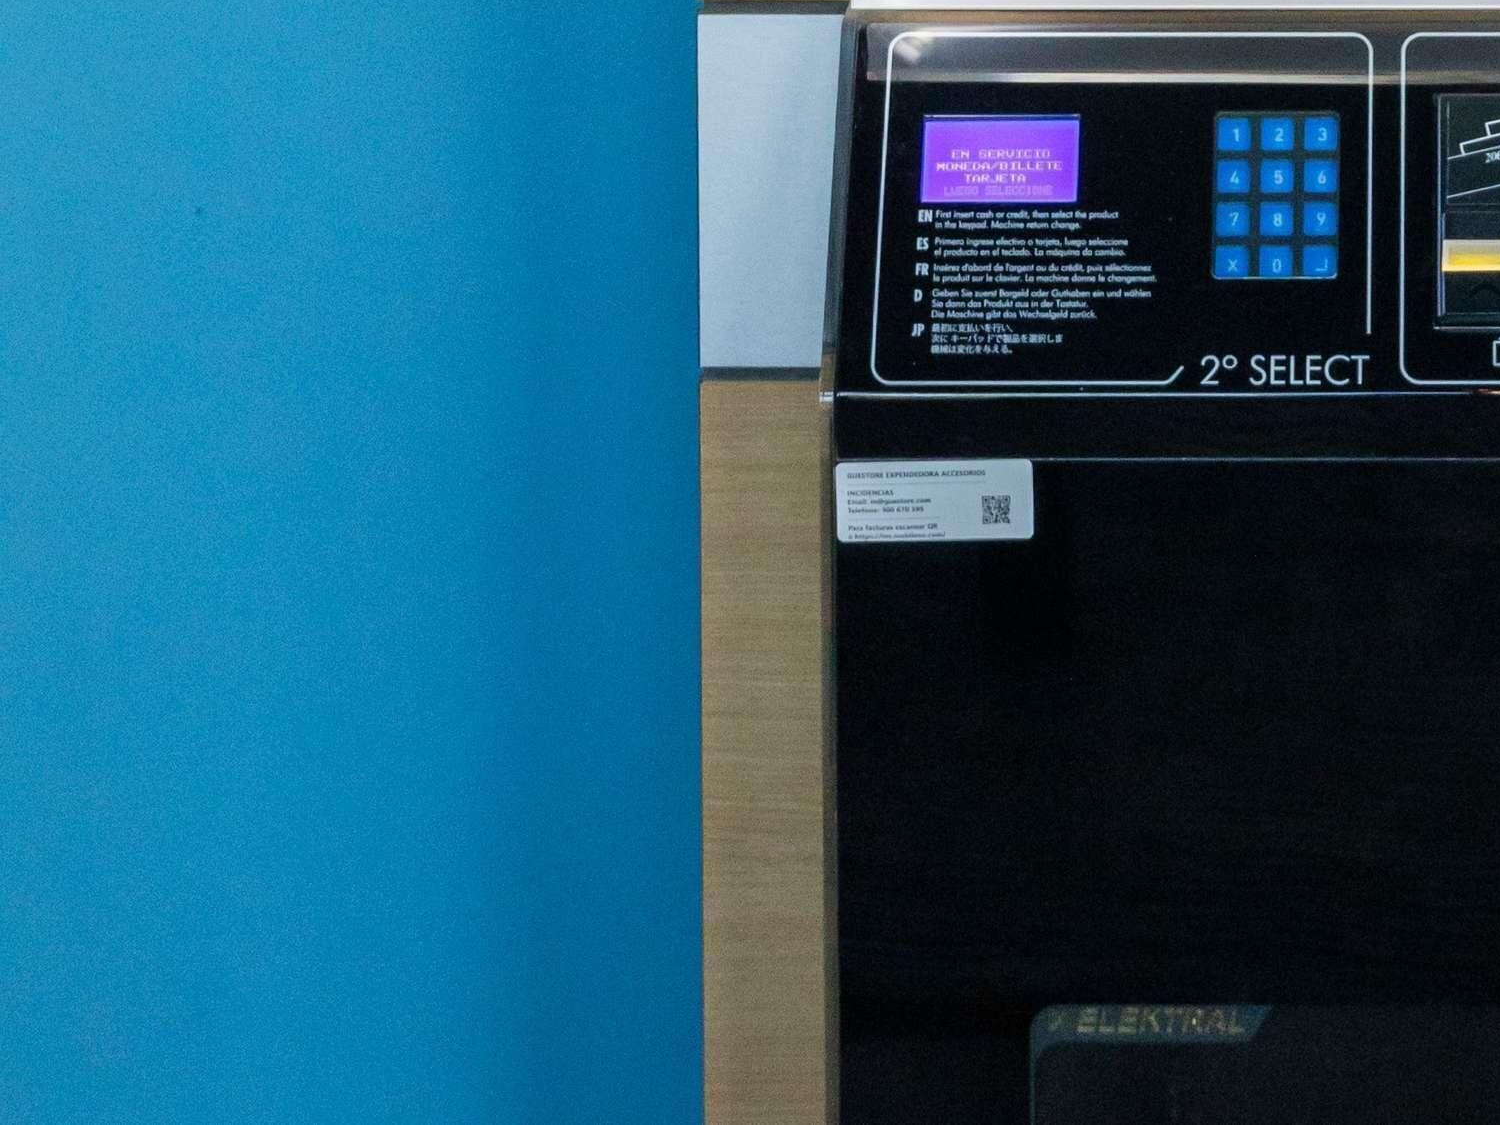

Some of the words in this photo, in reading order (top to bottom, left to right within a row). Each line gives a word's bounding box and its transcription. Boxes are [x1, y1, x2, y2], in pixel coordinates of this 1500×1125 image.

[1233, 128, 1240, 142] 1
[1274, 128, 1284, 142] 2
[1317, 127, 1327, 142] 3
[951, 150, 970, 160] EN
[979, 149, 1050, 159] SERVICIO
[936, 161, 1063, 172] MONEDA/BILLETE
[964, 173, 1026, 183] TARJETA
[1229, 170, 1239, 184] 4
[1274, 170, 1283, 184] 5
[1318, 170, 1326, 184] 6
[918, 210, 933, 222] EN
[1088, 211, 1119, 220] product
[1229, 211, 1239, 226] 7
[1273, 213, 1283, 227] 8
[1316, 213, 1326, 225] 9
[916, 237, 929, 251] ES
[915, 263, 929, 276] FR
[1272, 258, 1282, 273] 0
[914, 289, 923, 302] D
[911, 323, 925, 337] JP
[1249, 354, 1370, 386] SELECT
